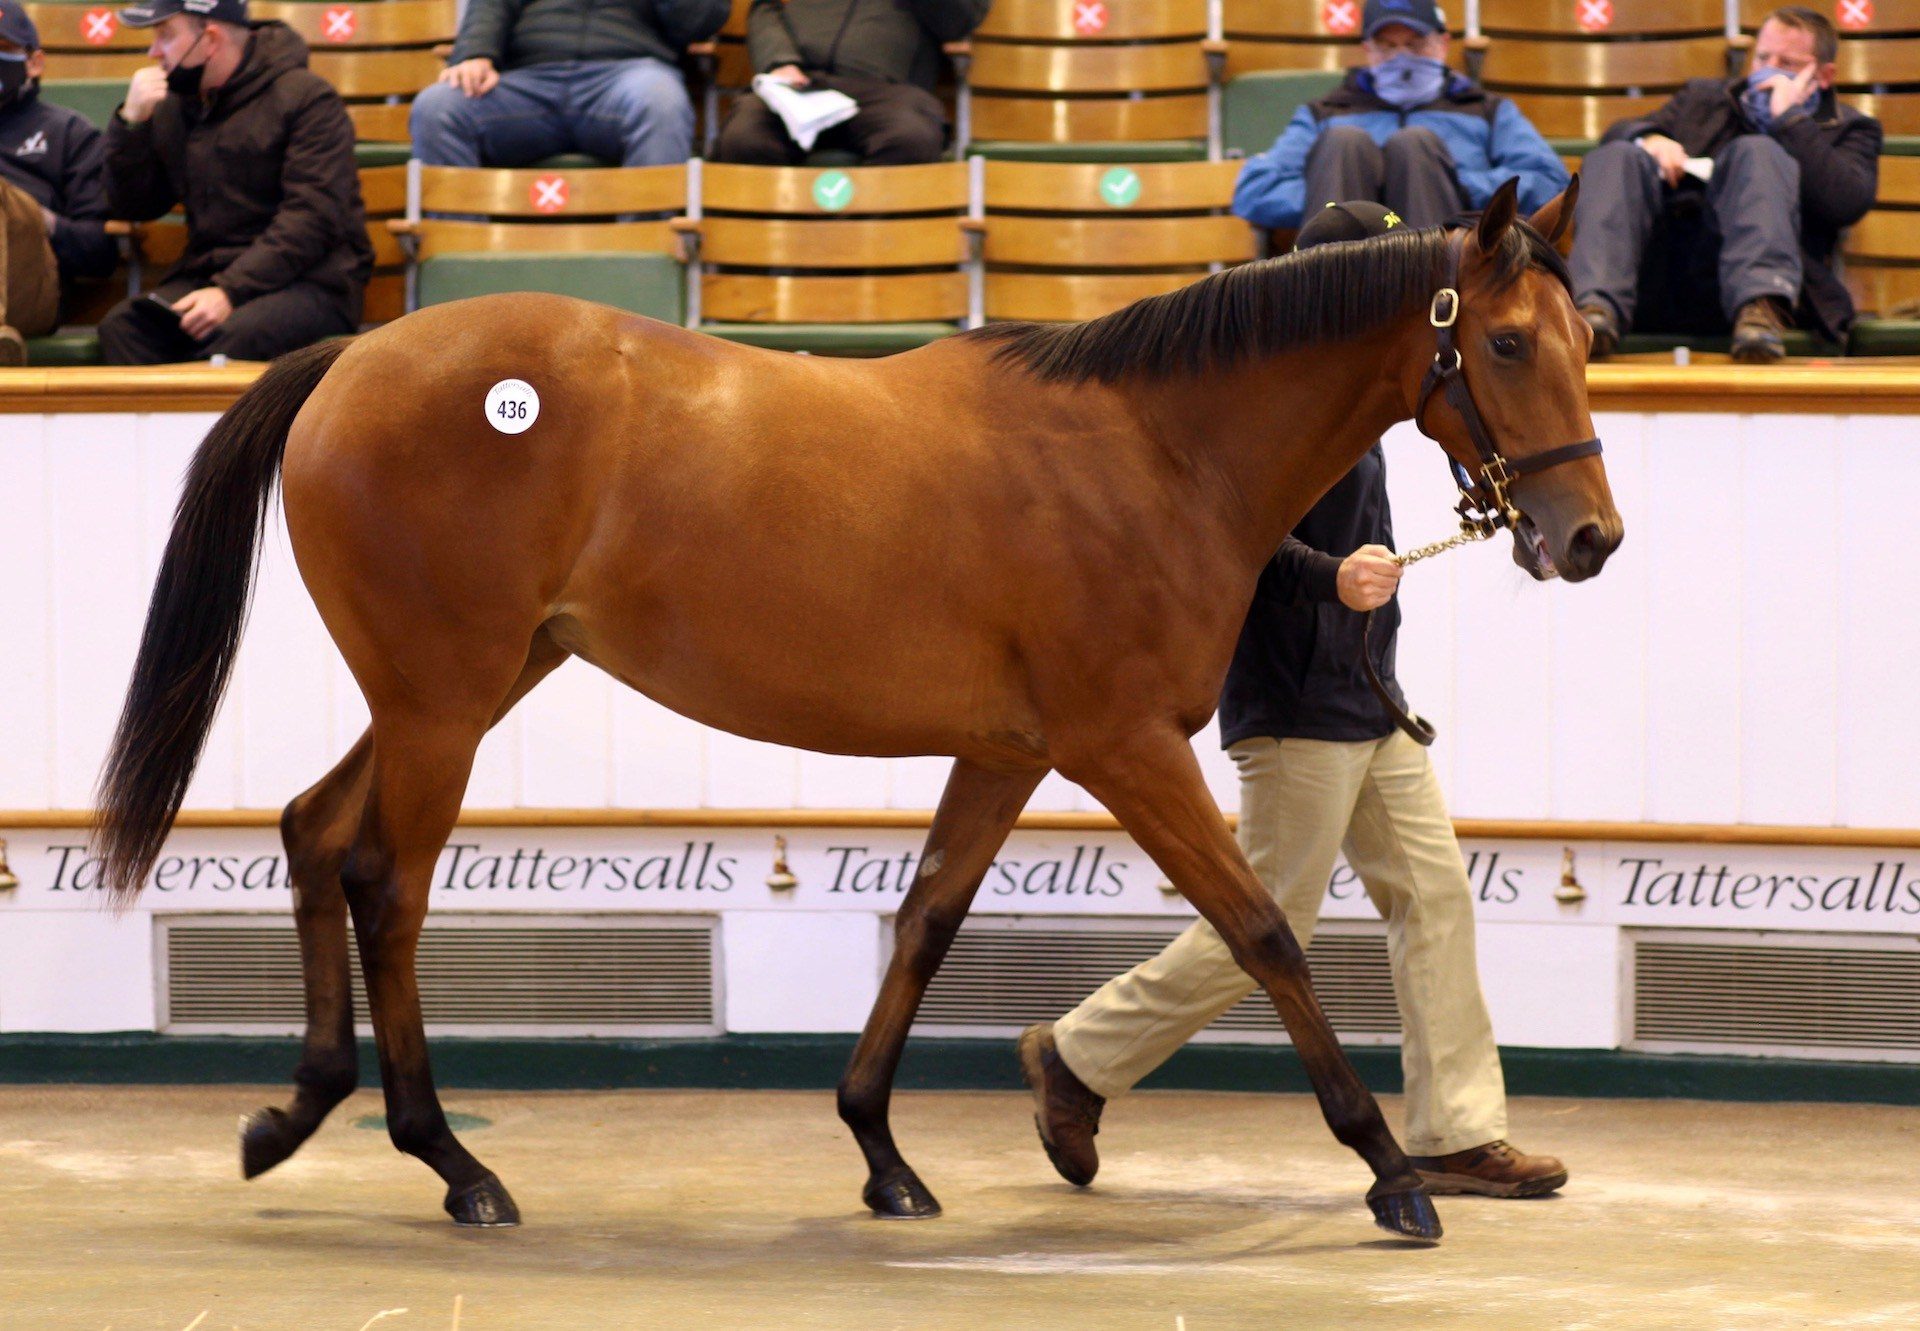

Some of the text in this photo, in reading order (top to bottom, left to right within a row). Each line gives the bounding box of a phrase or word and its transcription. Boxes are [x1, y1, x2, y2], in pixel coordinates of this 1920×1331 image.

[497, 400, 527, 419] 436
[440, 841, 738, 892] Tattersalls
[825, 845, 1128, 897] Tatsalls
